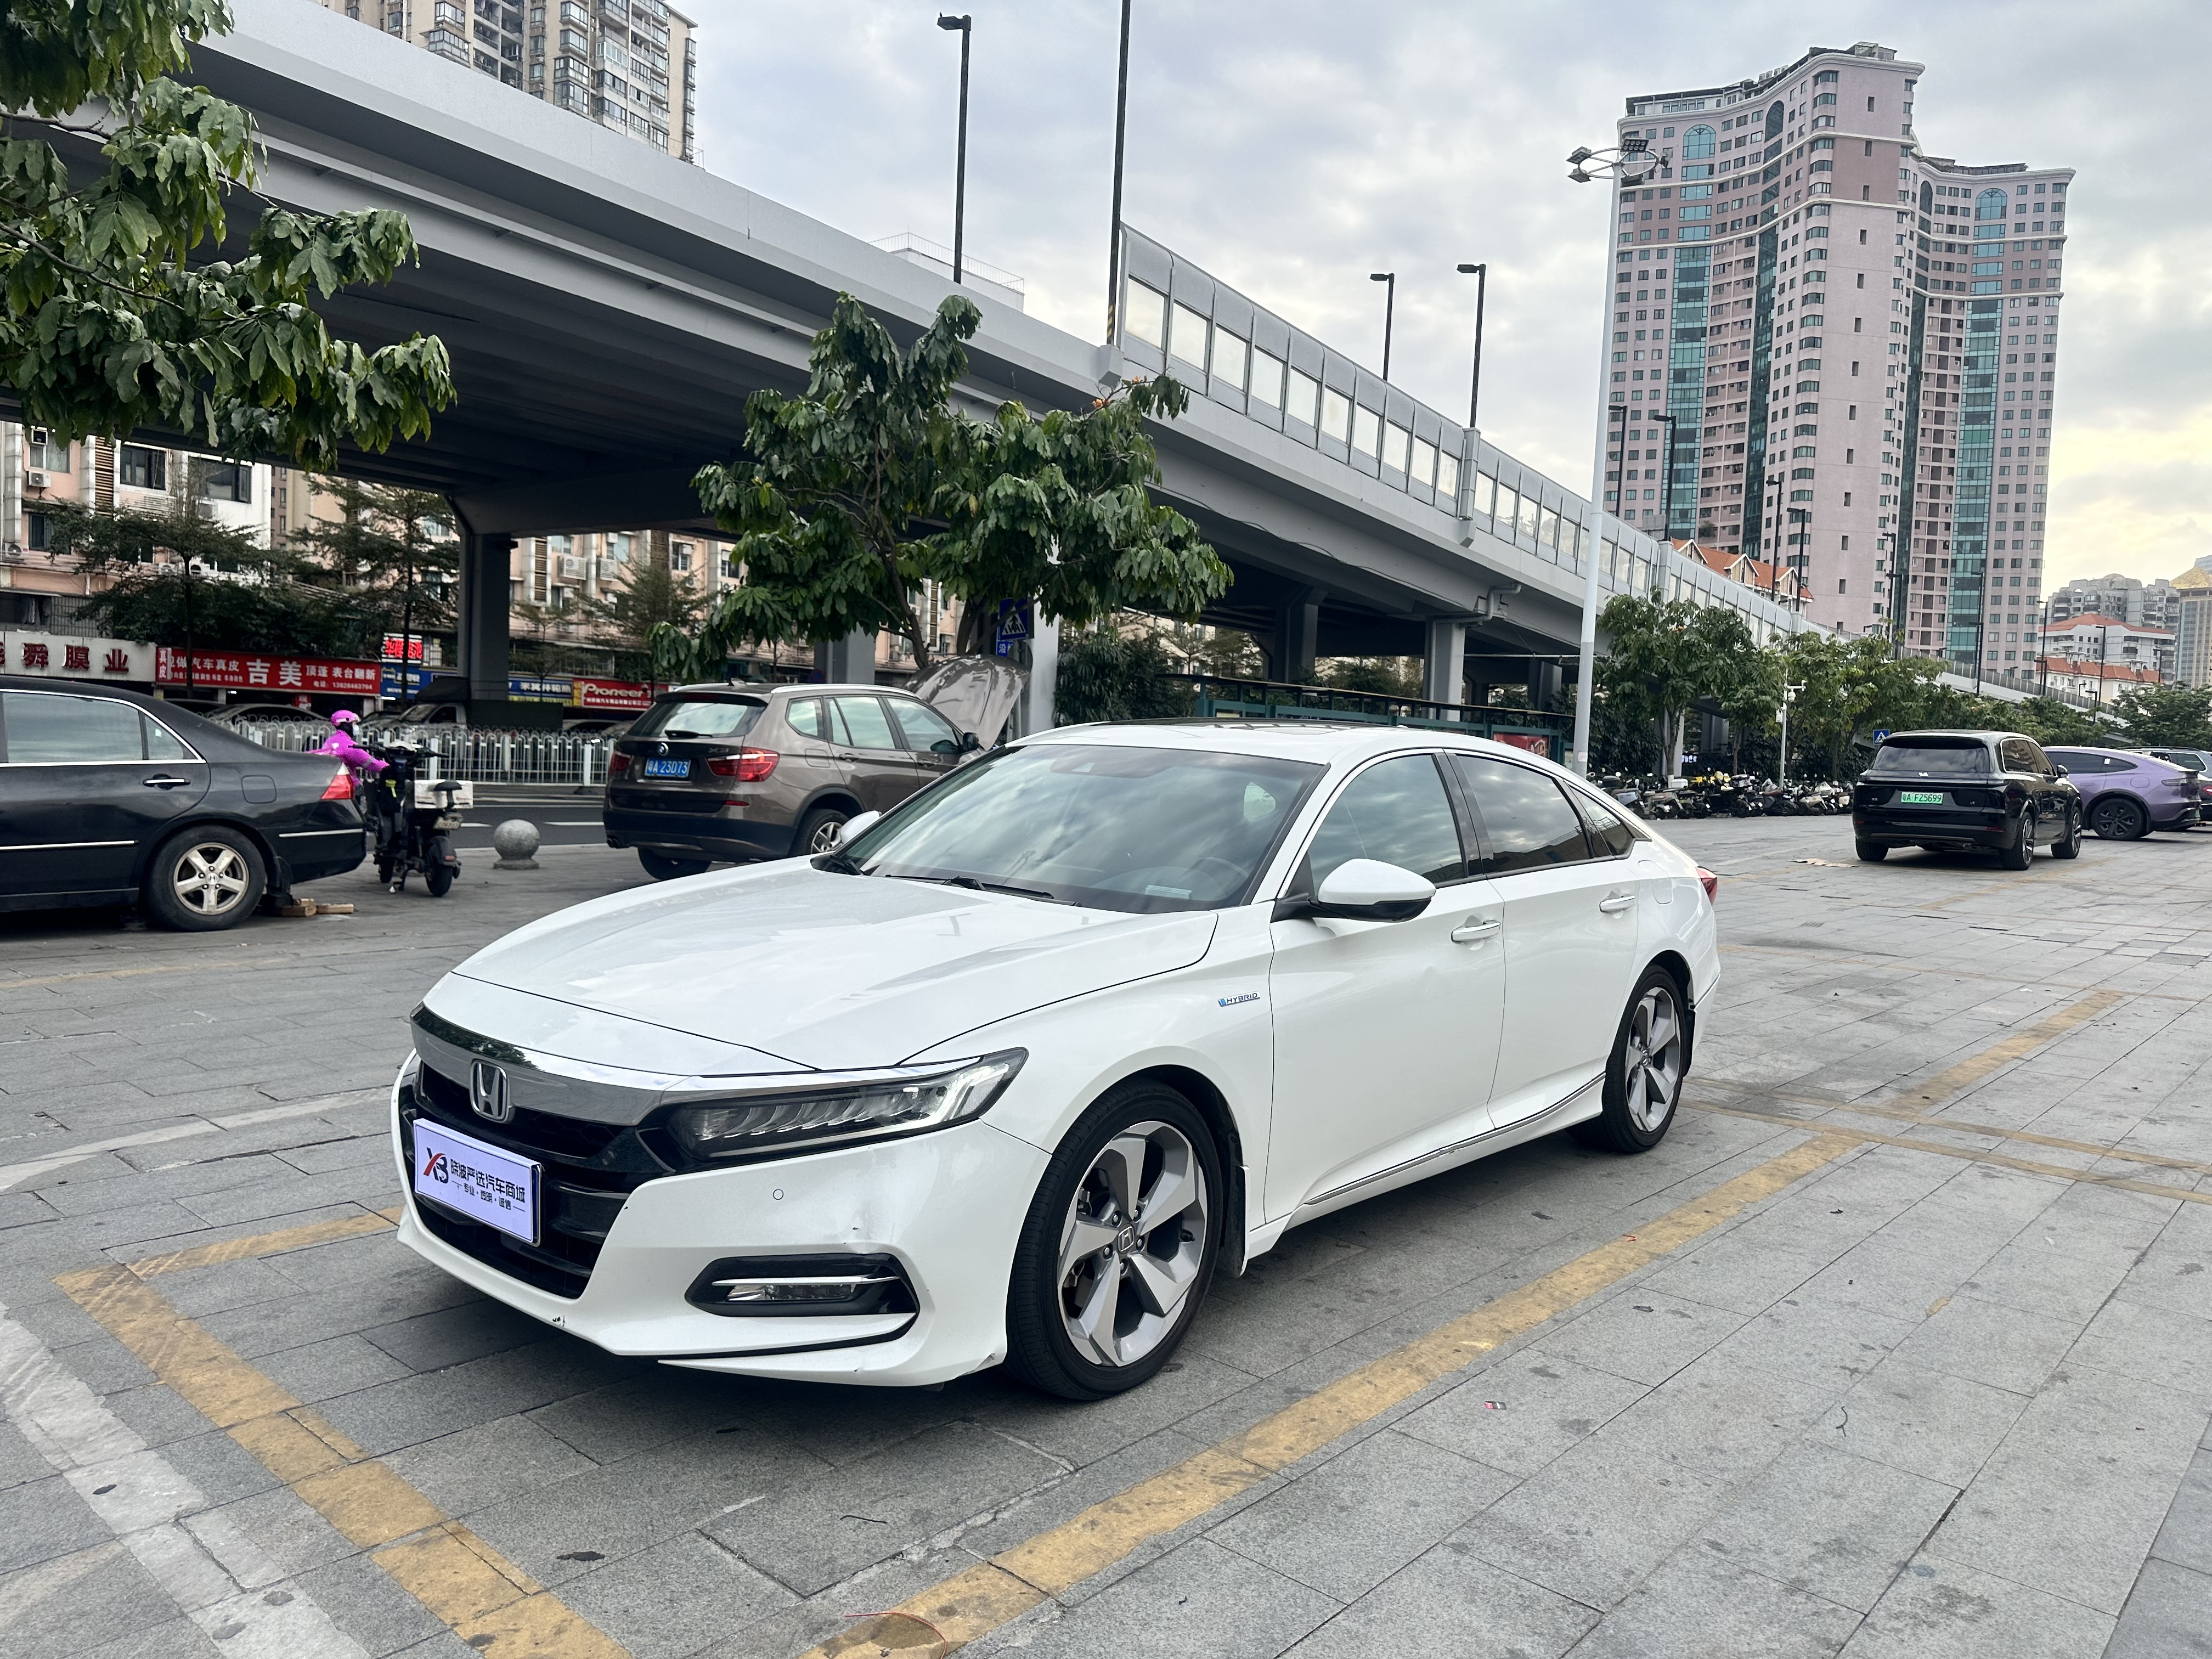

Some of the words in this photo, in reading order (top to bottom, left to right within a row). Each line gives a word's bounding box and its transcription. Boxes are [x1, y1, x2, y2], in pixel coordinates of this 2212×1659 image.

[159, 650, 167, 679] 真皮
[246, 658, 302, 686] 吉美
[1226, 992, 1257, 1004] HYBRID
[450, 1158, 526, 1204] 晓波严选汽车商城
